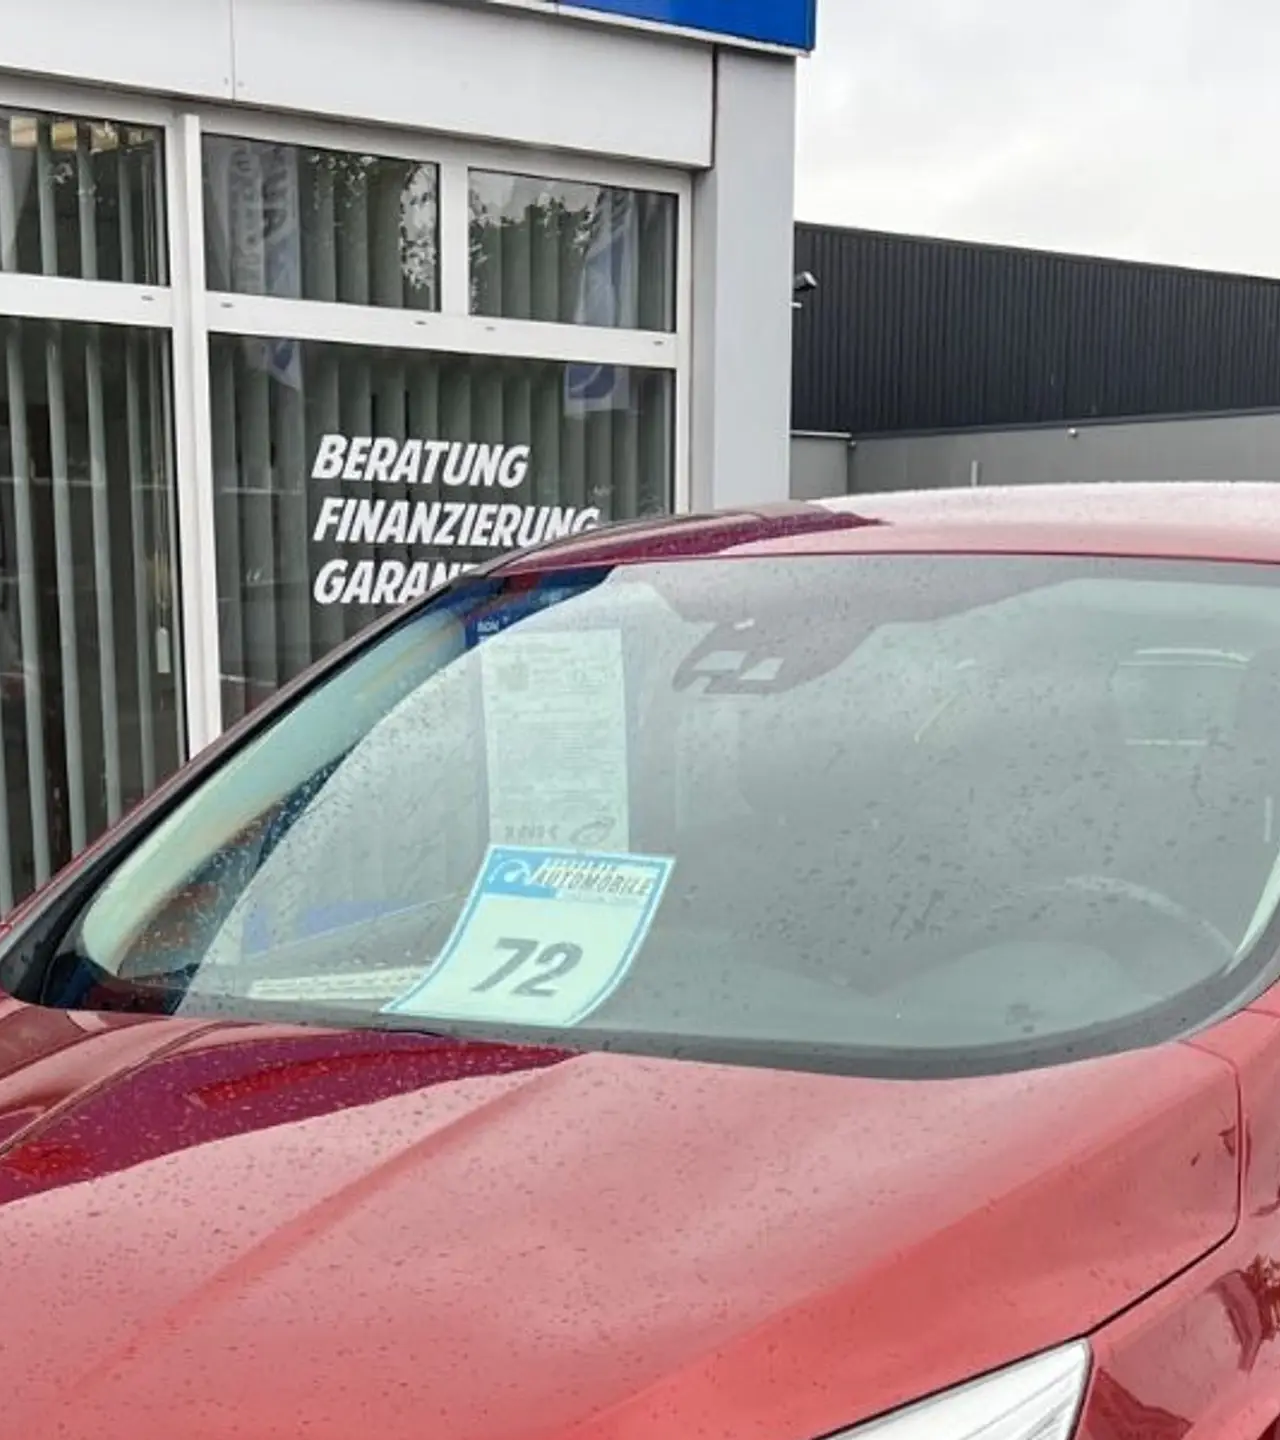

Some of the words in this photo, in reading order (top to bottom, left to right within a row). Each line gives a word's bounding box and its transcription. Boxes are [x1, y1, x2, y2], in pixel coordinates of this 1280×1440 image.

[311, 433, 531, 489] BERATUNG
[312, 497, 601, 548] FINANZIERUNG
[313, 558, 480, 605] GARAN
[470, 938, 584, 999] 72
